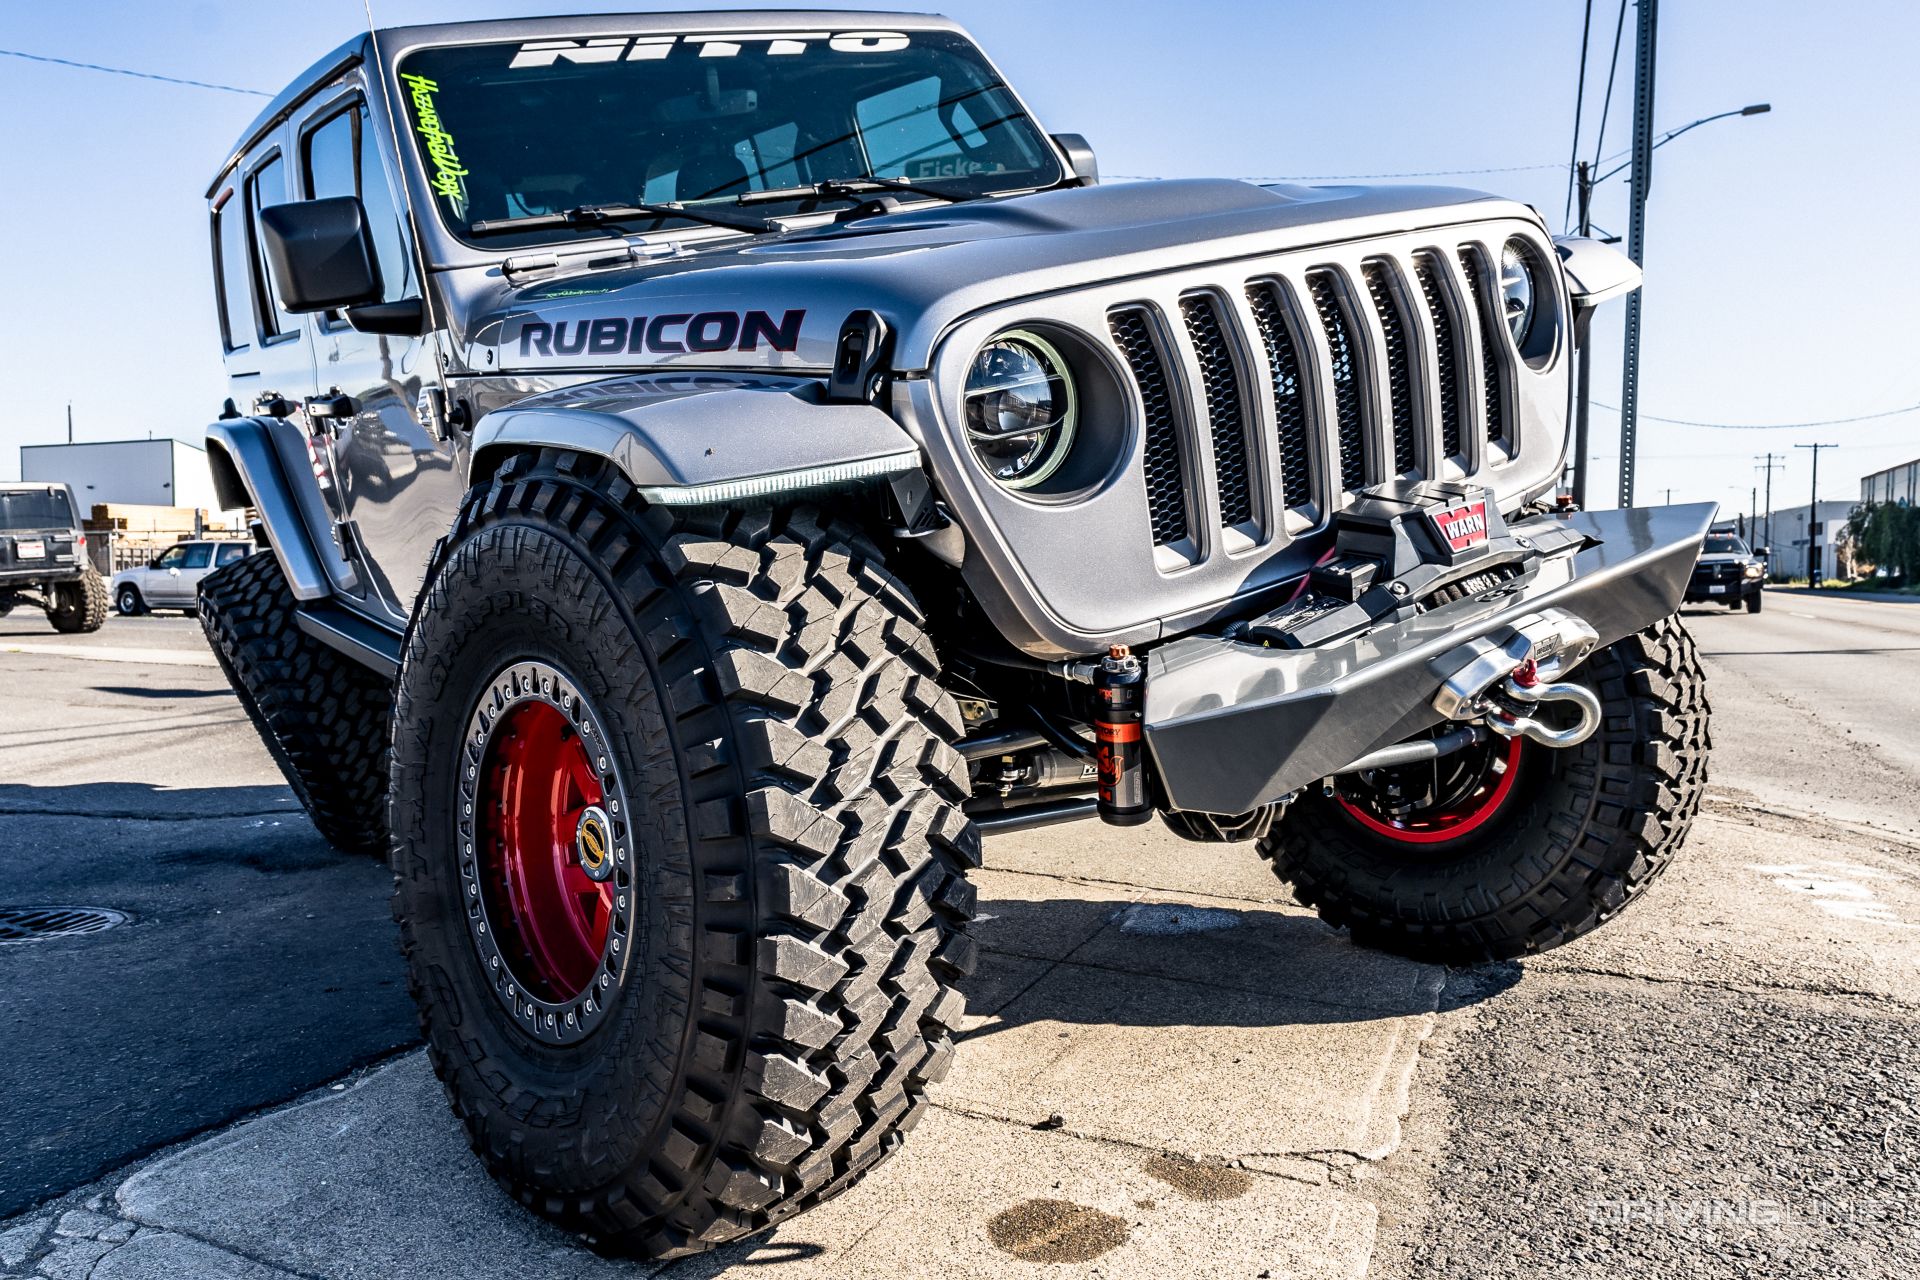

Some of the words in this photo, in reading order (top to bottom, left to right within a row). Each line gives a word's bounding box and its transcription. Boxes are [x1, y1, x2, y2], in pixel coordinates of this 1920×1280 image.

[508, 32, 911, 69] NITTO
[519, 309, 807, 358] RUBICON
[1445, 513, 1485, 540] WARN
